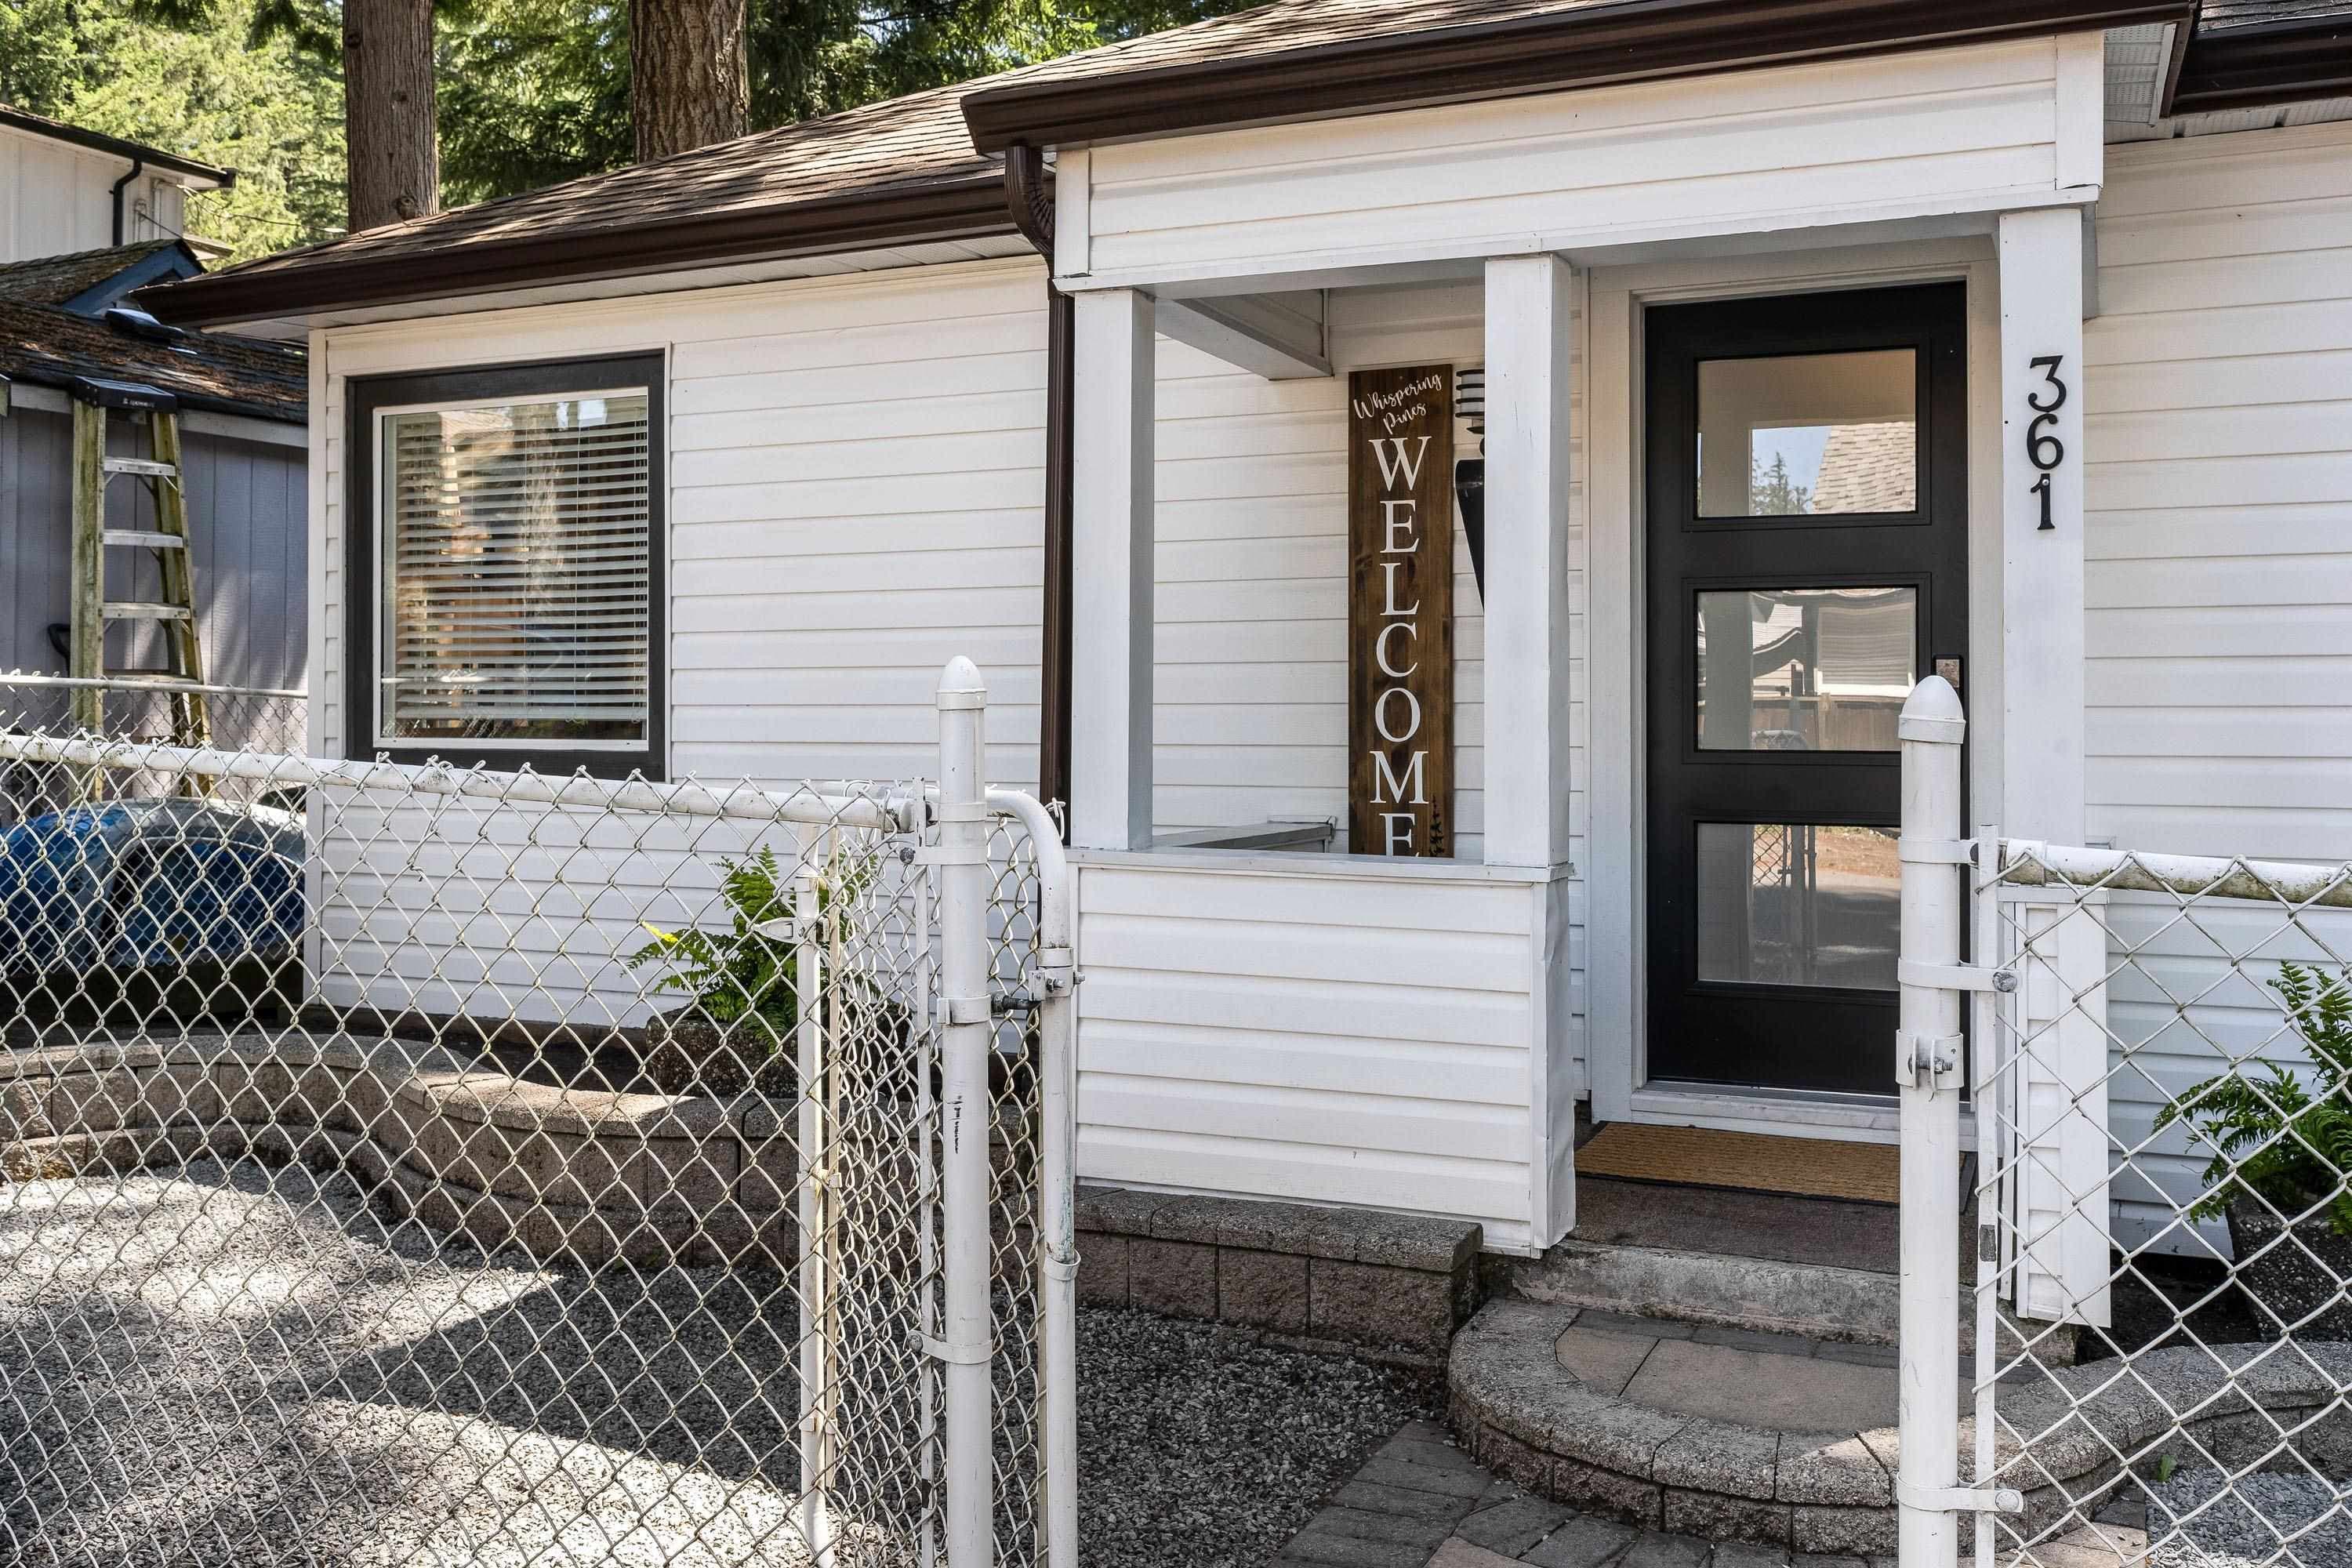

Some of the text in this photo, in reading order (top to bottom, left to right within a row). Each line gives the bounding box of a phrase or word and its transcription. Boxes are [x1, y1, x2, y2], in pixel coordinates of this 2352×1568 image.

[1353, 374, 1442, 419] Whispering
[1383, 403, 1427, 435] Pines
[2027, 355, 2067, 530] 361
[1368, 436, 1432, 858] WELCOME
